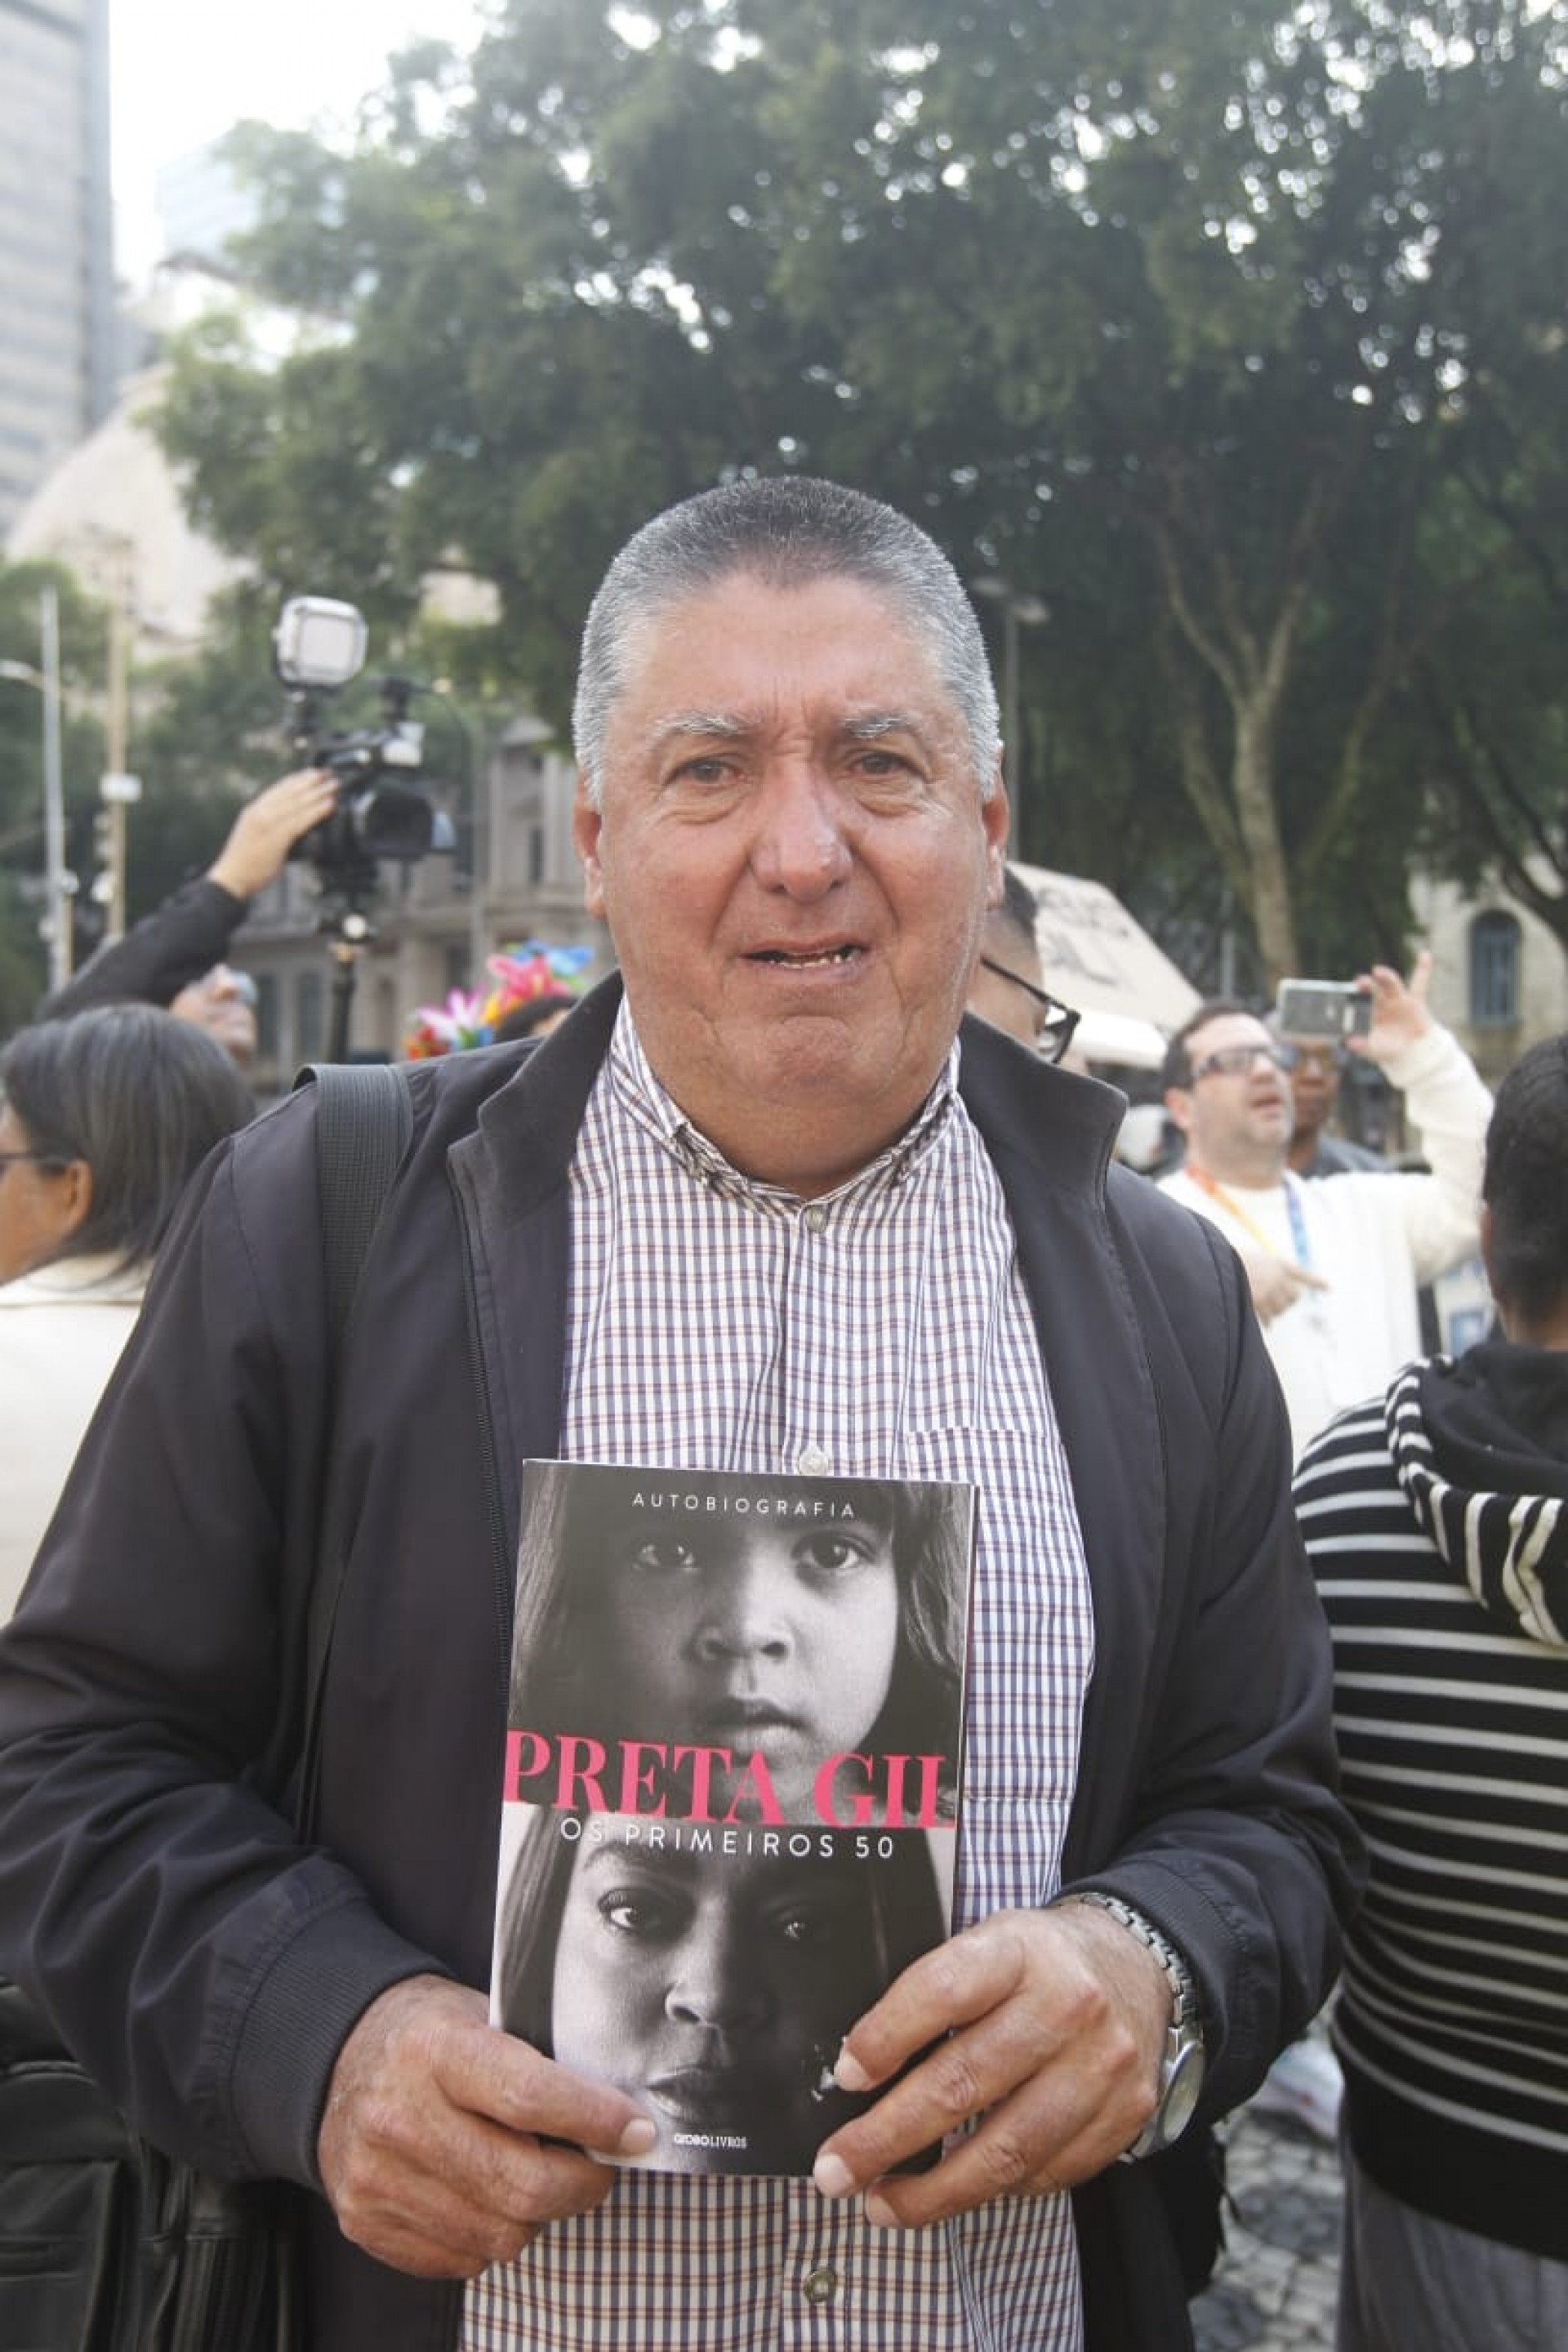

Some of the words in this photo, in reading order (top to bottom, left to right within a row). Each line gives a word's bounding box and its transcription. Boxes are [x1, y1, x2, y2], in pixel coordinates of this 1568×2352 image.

[632, 1492, 854, 1518] AUTOBIOGRAFIA
[504, 1729, 786, 1824] PRETA
[560, 1817, 604, 1842] OS
[626, 1824, 834, 1858] PRIMEIROS
[856, 1834, 893, 1858] 50
